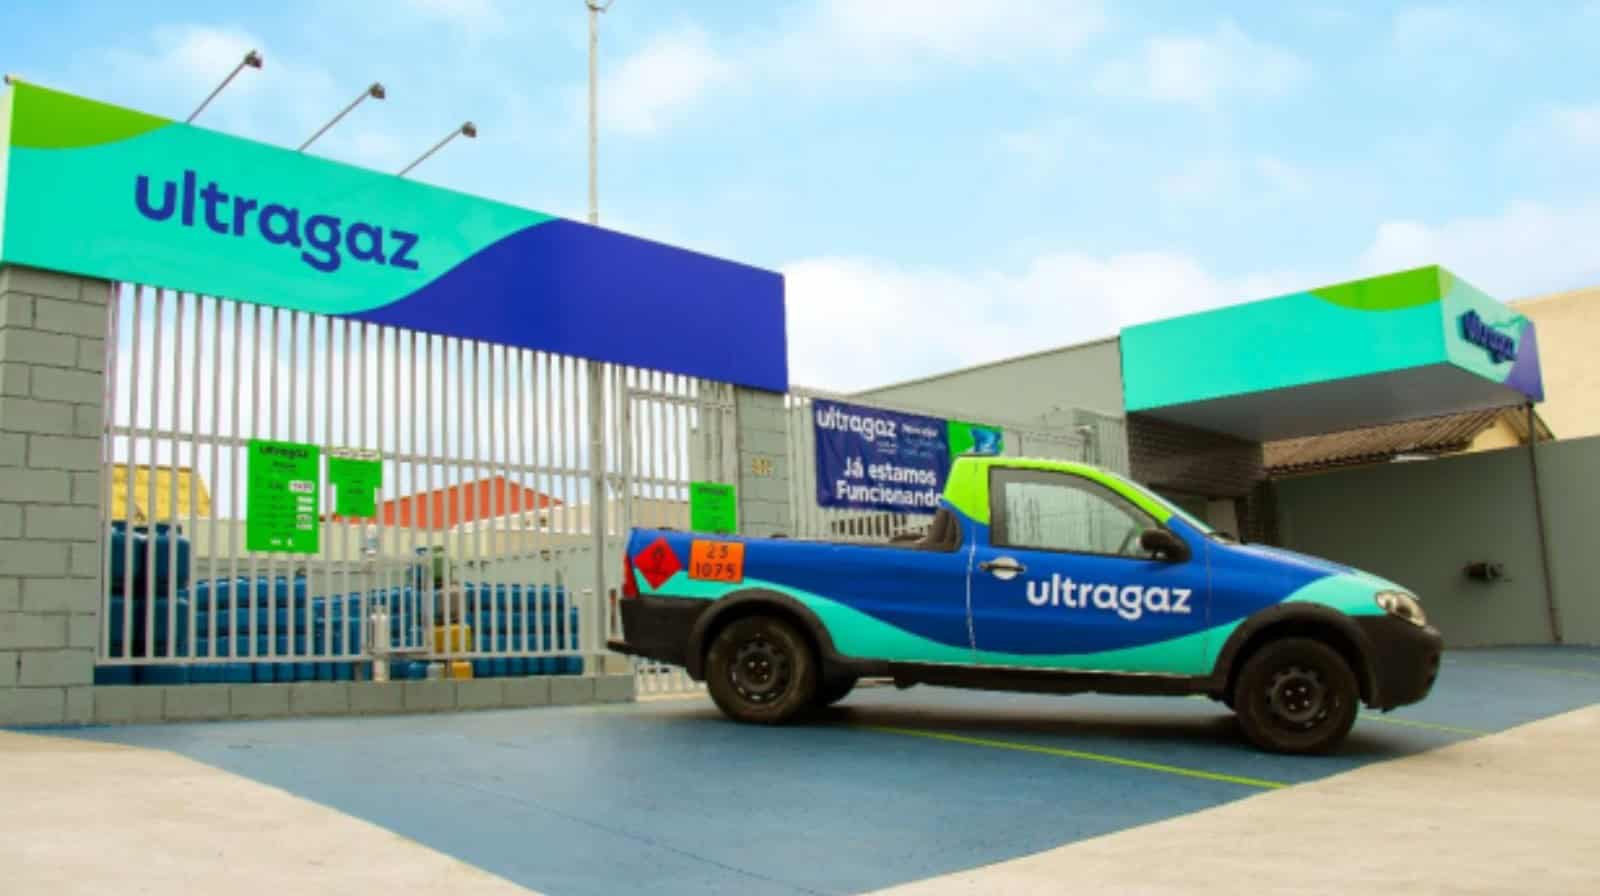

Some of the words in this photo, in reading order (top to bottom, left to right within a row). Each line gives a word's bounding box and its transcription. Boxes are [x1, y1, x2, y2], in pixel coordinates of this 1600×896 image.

[135, 170, 419, 272] ultragaz
[816, 407, 897, 442] ultragaz
[844, 456, 863, 478] Já
[868, 459, 937, 486] estamos
[696, 560, 736, 579] 1075
[1026, 573, 1192, 620] ultragaz
